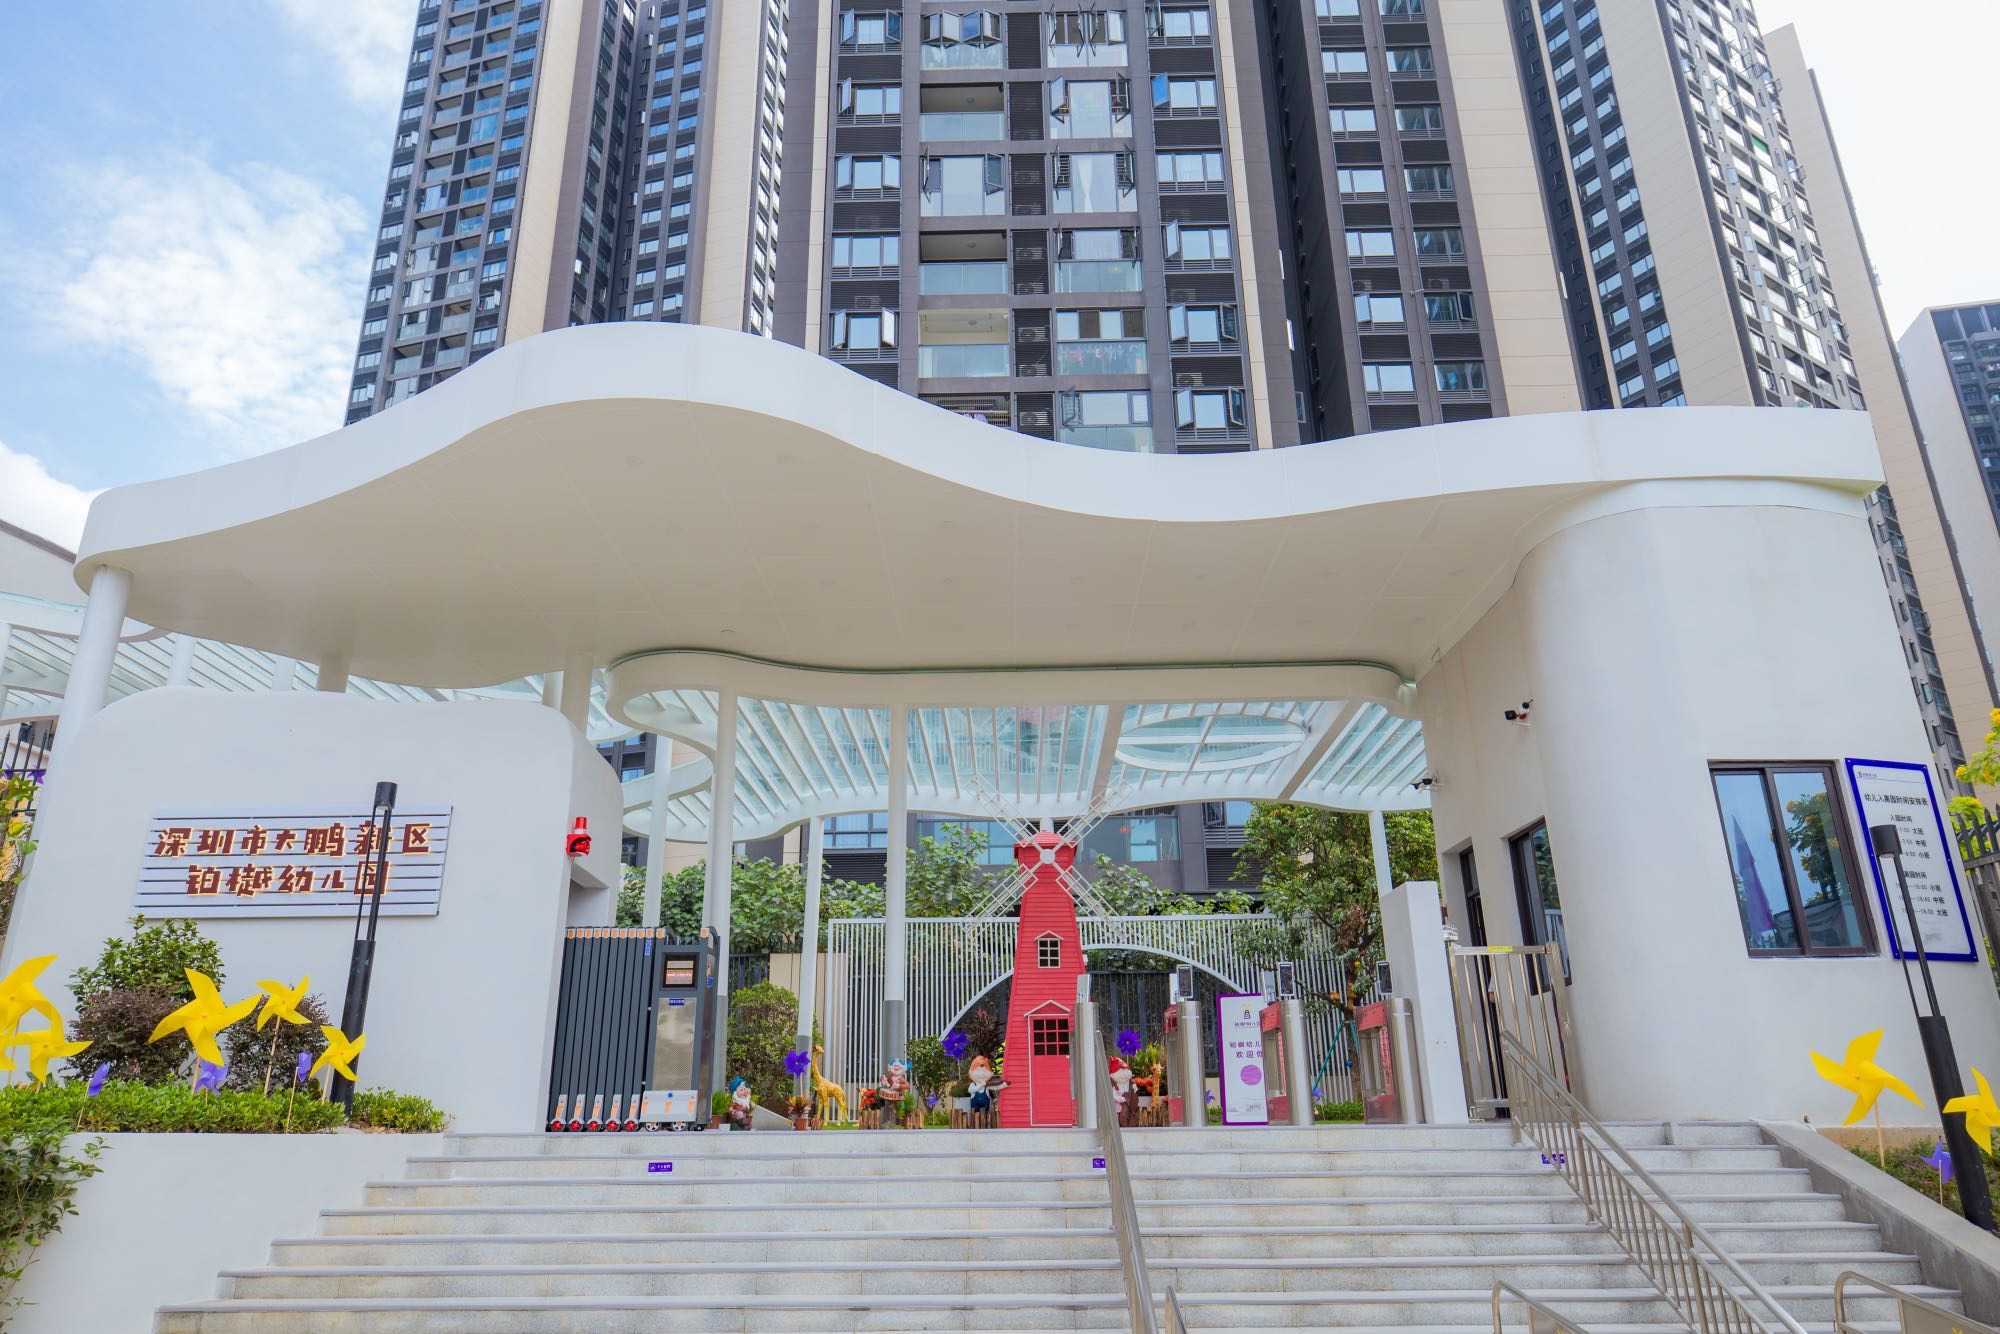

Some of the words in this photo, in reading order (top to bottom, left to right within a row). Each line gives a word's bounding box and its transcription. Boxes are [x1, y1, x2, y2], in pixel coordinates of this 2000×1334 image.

[154, 820, 431, 857] 深圳市大鹏新区
[186, 861, 390, 897] 铂樾幼儿园
